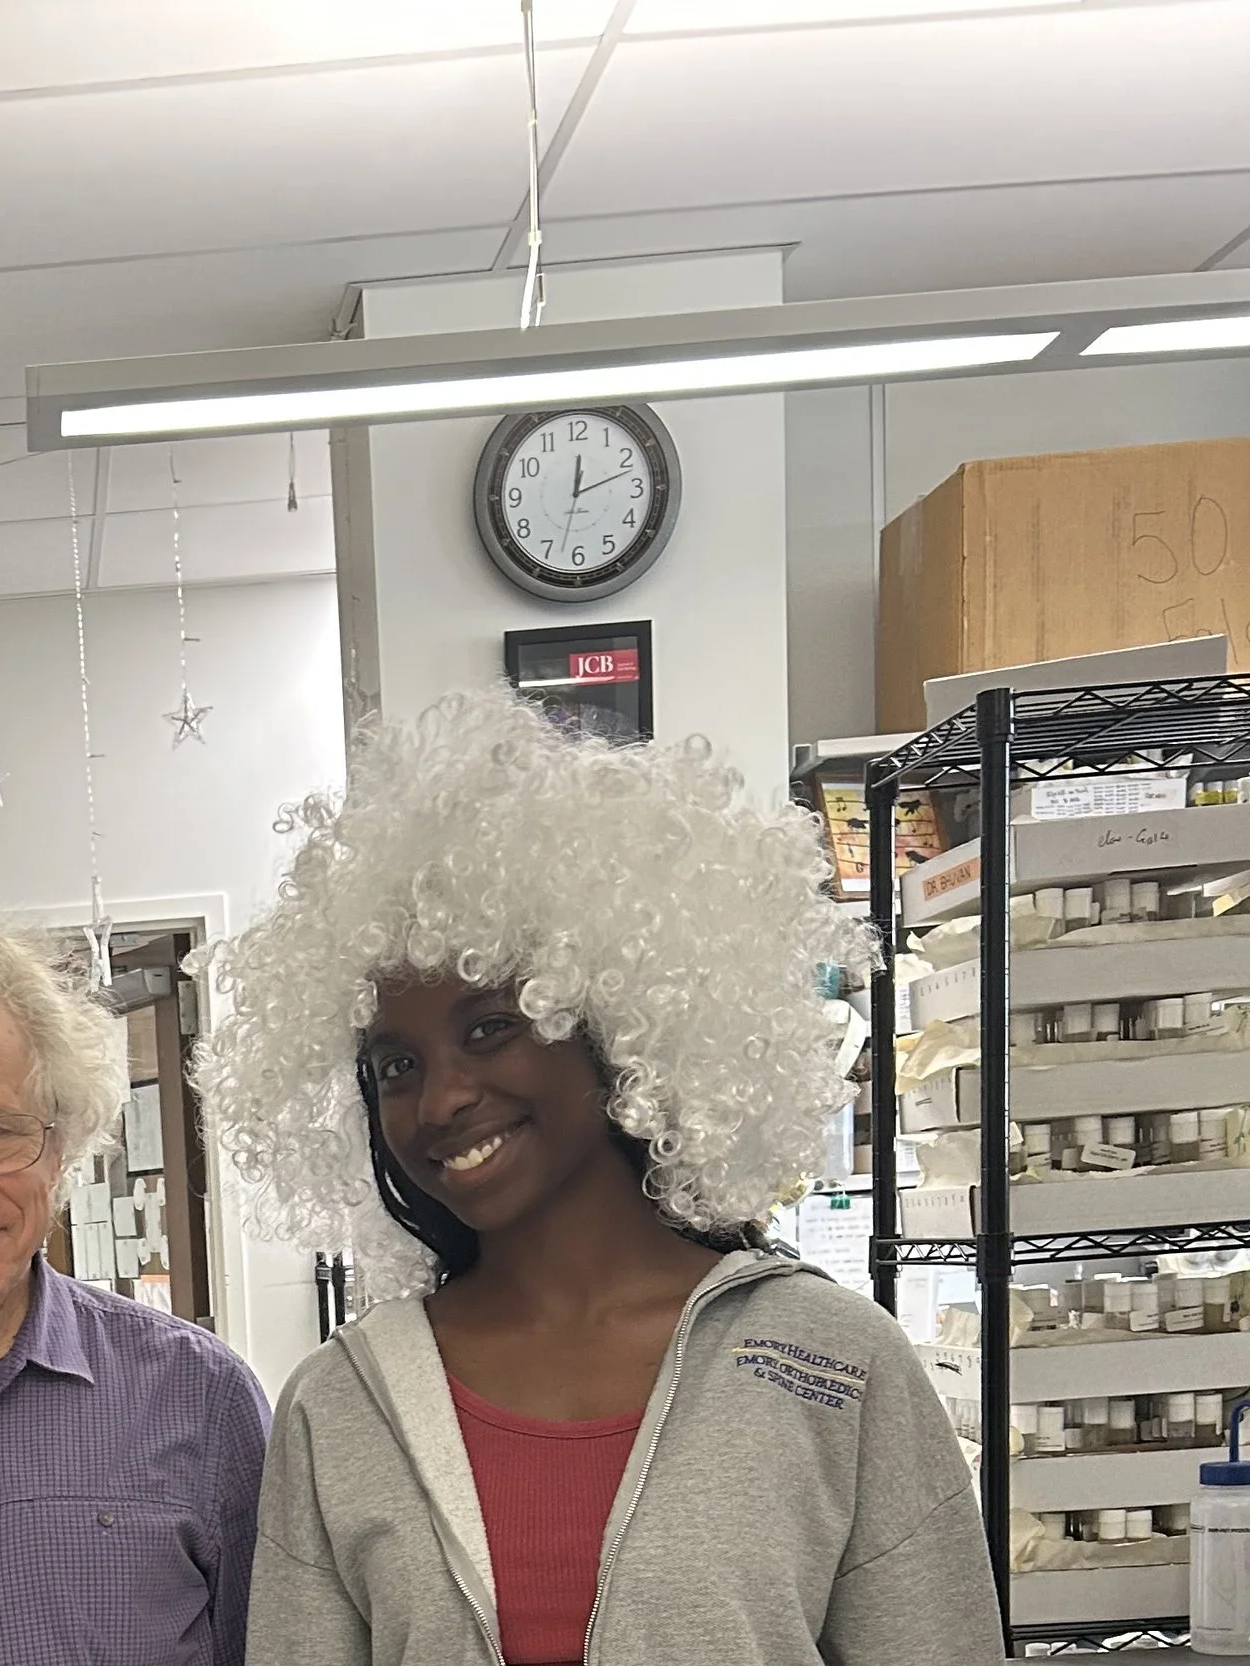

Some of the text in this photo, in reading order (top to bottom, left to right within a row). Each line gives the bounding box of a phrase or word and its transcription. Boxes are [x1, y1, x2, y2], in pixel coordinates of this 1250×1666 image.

[567, 419, 589, 442] 12
[602, 427, 611, 448] 1
[540, 432, 556, 453] 11
[519, 456, 541, 478] 10
[619, 447, 634, 469] 2
[508, 487, 523, 509] 9
[630, 477, 644, 499] 3
[516, 518, 532, 539] 8
[622, 507, 637, 529] 4
[540, 539, 554, 560] 7
[602, 534, 616, 556] 5
[1132, 497, 1228, 584] 50
[571, 545, 586, 567] 6
[575, 654, 614, 679] JCB
[744, 1338, 787, 1354] EMORY
[736, 1354, 780, 1370] EMORY
[753, 1367, 766, 1379] &
[795, 1385, 845, 1410] CENTER
